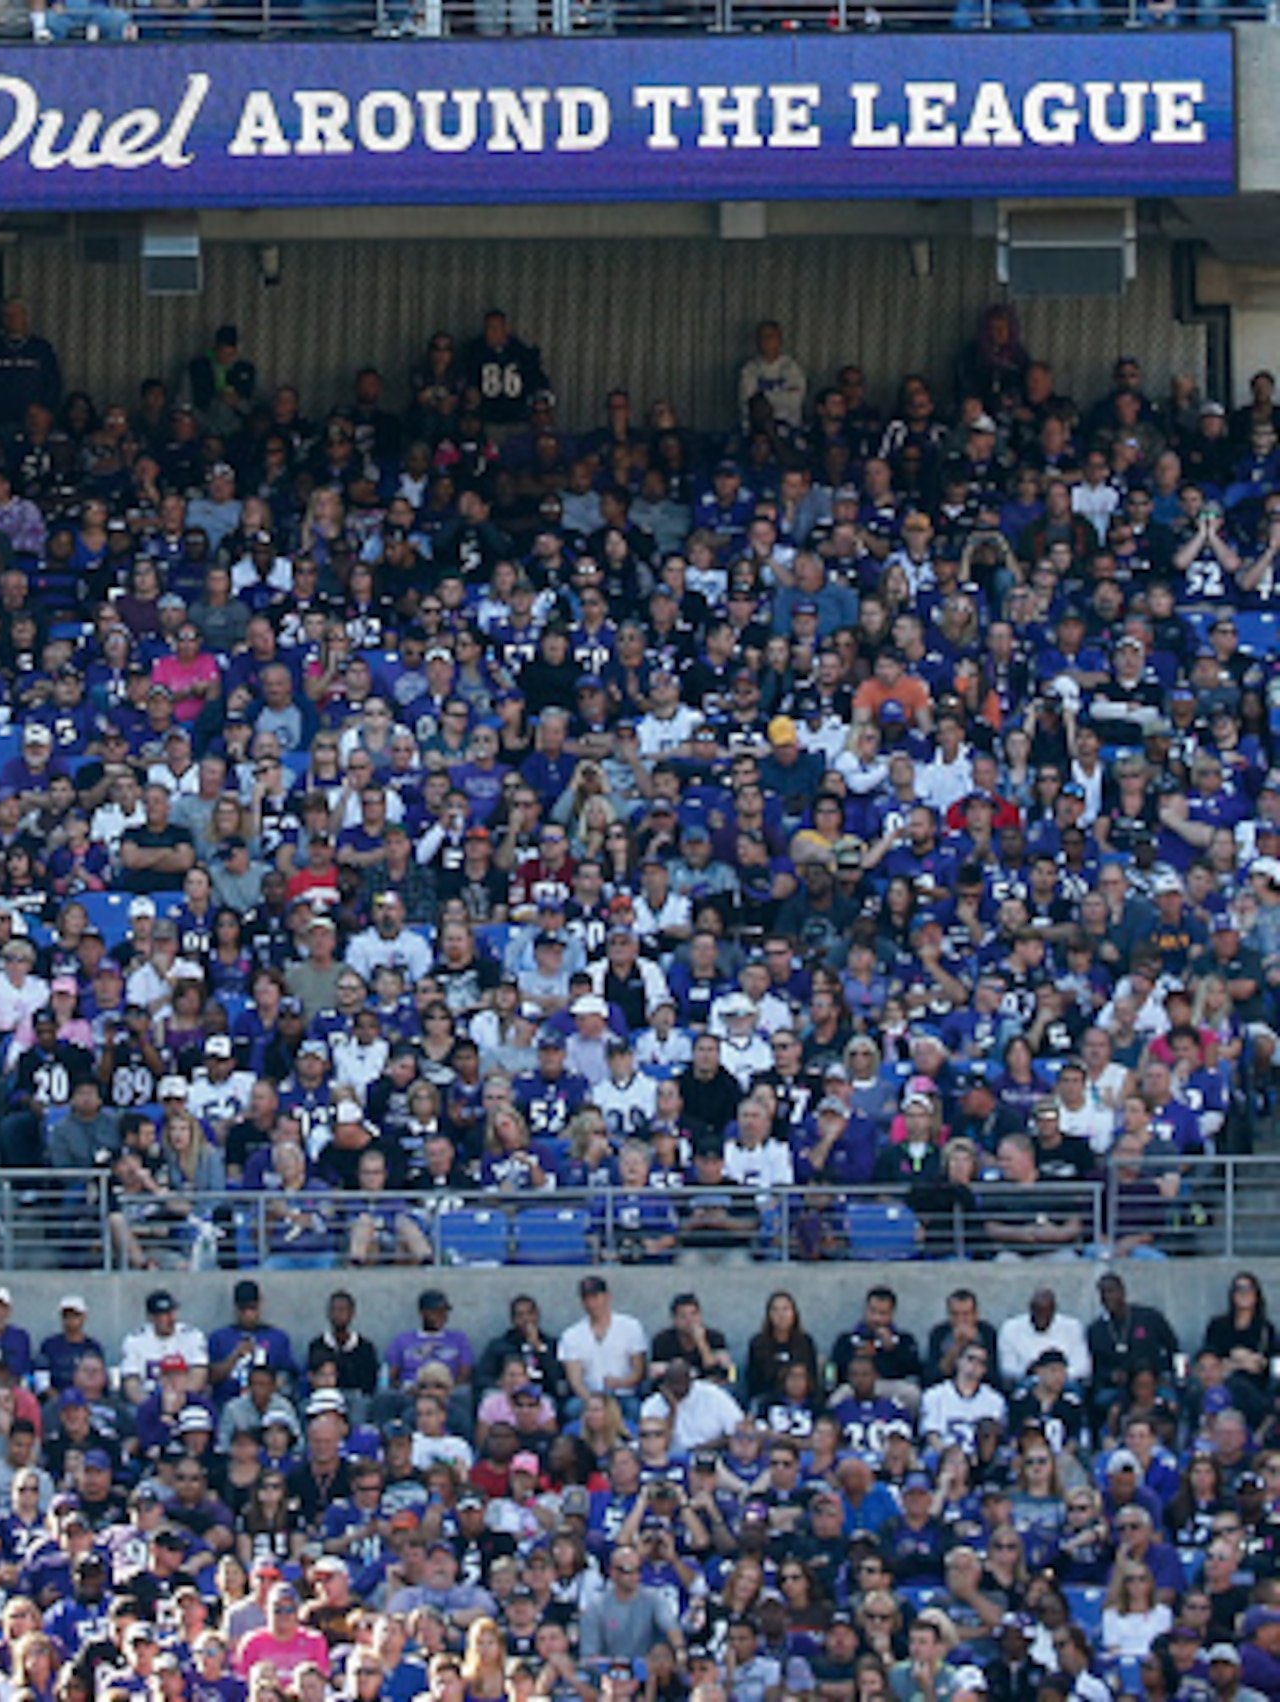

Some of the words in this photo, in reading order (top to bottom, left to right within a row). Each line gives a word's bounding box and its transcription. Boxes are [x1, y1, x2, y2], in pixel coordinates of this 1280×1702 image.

[228, 87, 612, 156] AROUND
[633, 84, 821, 150] THE
[850, 80, 1205, 147] LEAGUE
[481, 362, 523, 399] 86
[1185, 560, 1225, 597] 52
[33, 1064, 69, 1103] 20
[111, 1064, 151, 1106] 89
